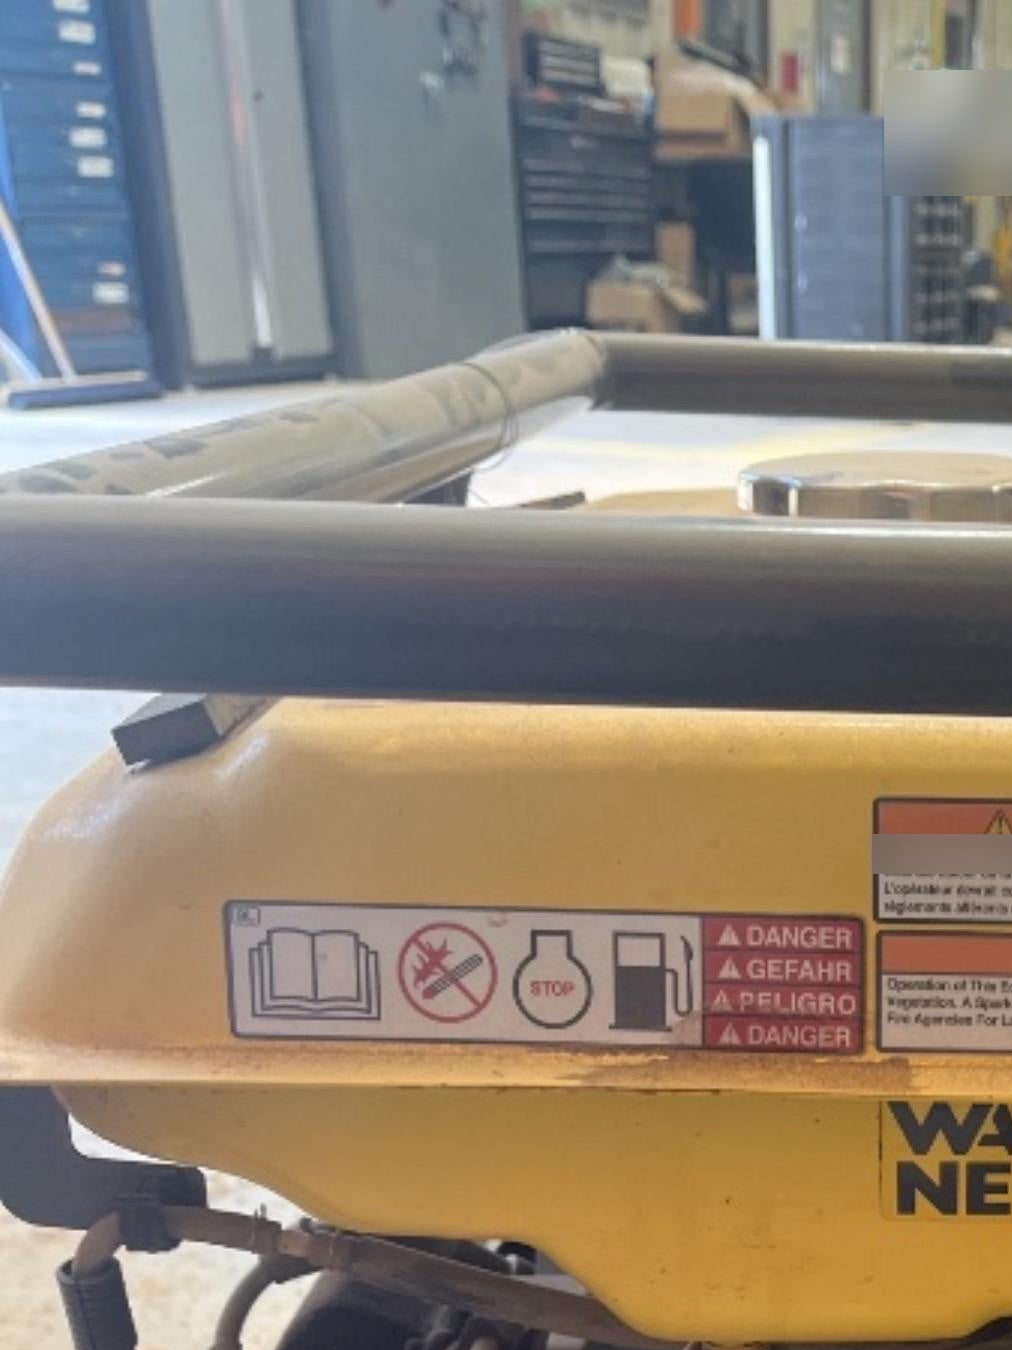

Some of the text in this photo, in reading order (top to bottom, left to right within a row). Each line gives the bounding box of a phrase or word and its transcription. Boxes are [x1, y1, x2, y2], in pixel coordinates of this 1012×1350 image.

[746, 925, 853, 949] DANGER
[746, 959, 853, 982] GEFAHR
[529, 980, 575, 998] STOP
[741, 993, 856, 1017] PELIGRO
[746, 1024, 853, 1048] DANGER
